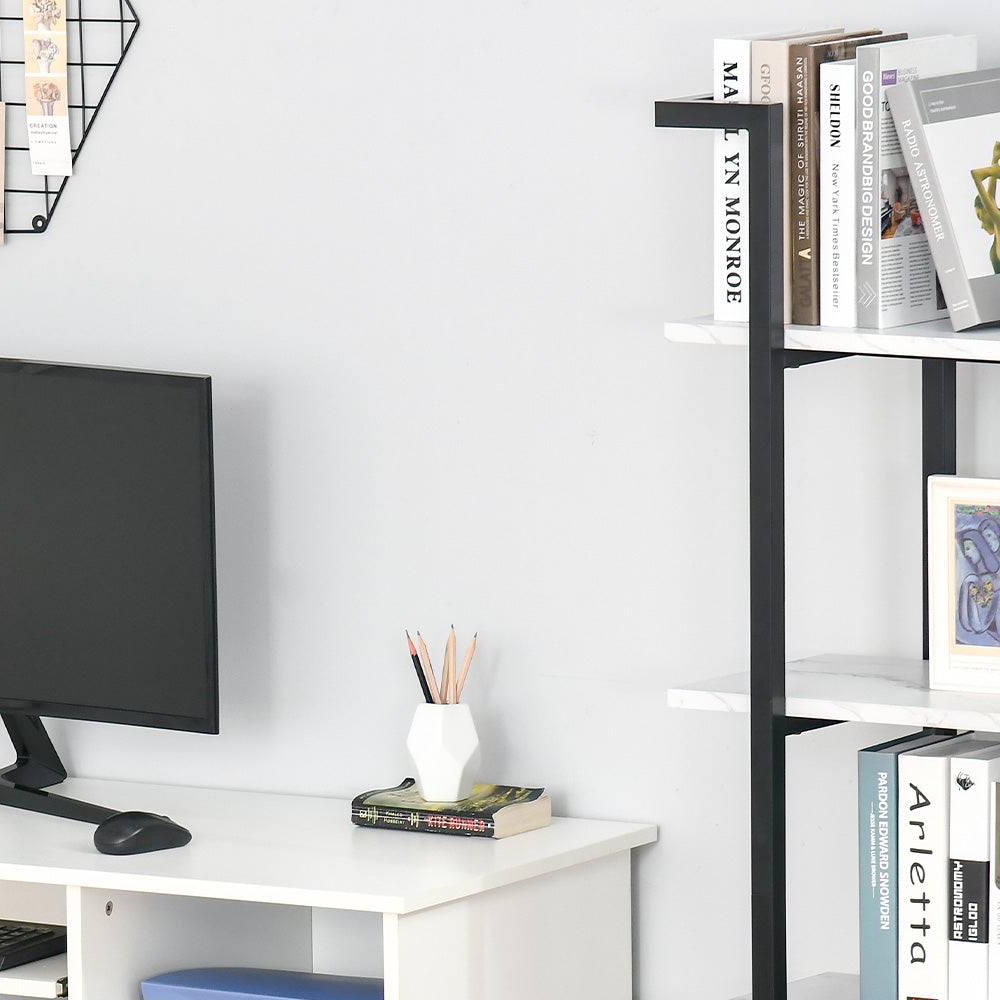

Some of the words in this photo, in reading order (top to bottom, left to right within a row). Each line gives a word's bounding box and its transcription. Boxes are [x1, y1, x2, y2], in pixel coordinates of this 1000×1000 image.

[796, 57, 804, 104] HAASAN
[862, 70, 874, 119] GOOD
[797, 109, 805, 148] SHRUTI
[829, 83, 841, 148] SHELDON
[797, 153, 805, 169] OF
[832, 163, 840, 187] New
[902, 119, 921, 158] RADIO
[914, 161, 945, 243] ASTRONOMER
[797, 174, 806, 215] MAGIC
[725, 196, 742, 304] MONROE
[798, 220, 806, 240] THE
[832, 217, 840, 250] Times
[861, 205, 873, 266] DESIGN
[878, 772, 889, 820] PARDON
[427, 814, 448, 829] KITE
[448, 816, 485, 832] RUNNER
[878, 822, 889, 870] EDWARD
[908, 782, 934, 965] Arletta
[879, 872, 890, 931] SNOWDEN
[968, 902, 978, 941] IGLOO
